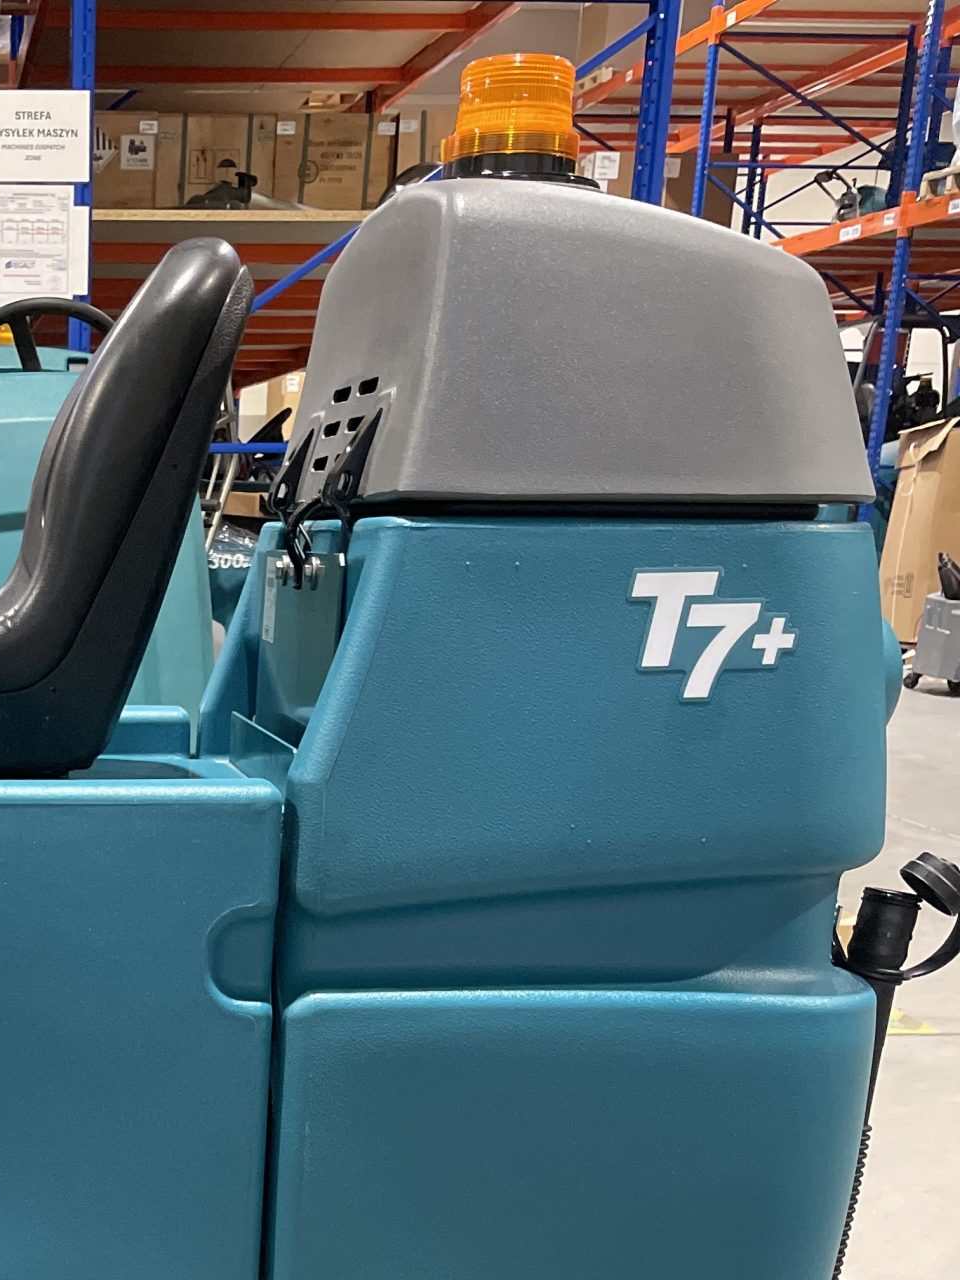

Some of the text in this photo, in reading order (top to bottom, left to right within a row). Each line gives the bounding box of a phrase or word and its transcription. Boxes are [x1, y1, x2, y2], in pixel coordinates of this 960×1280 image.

[14, 111, 52, 121] STREFA
[36, 127, 79, 138] MASZYN
[631, 571, 796, 698] T7+
